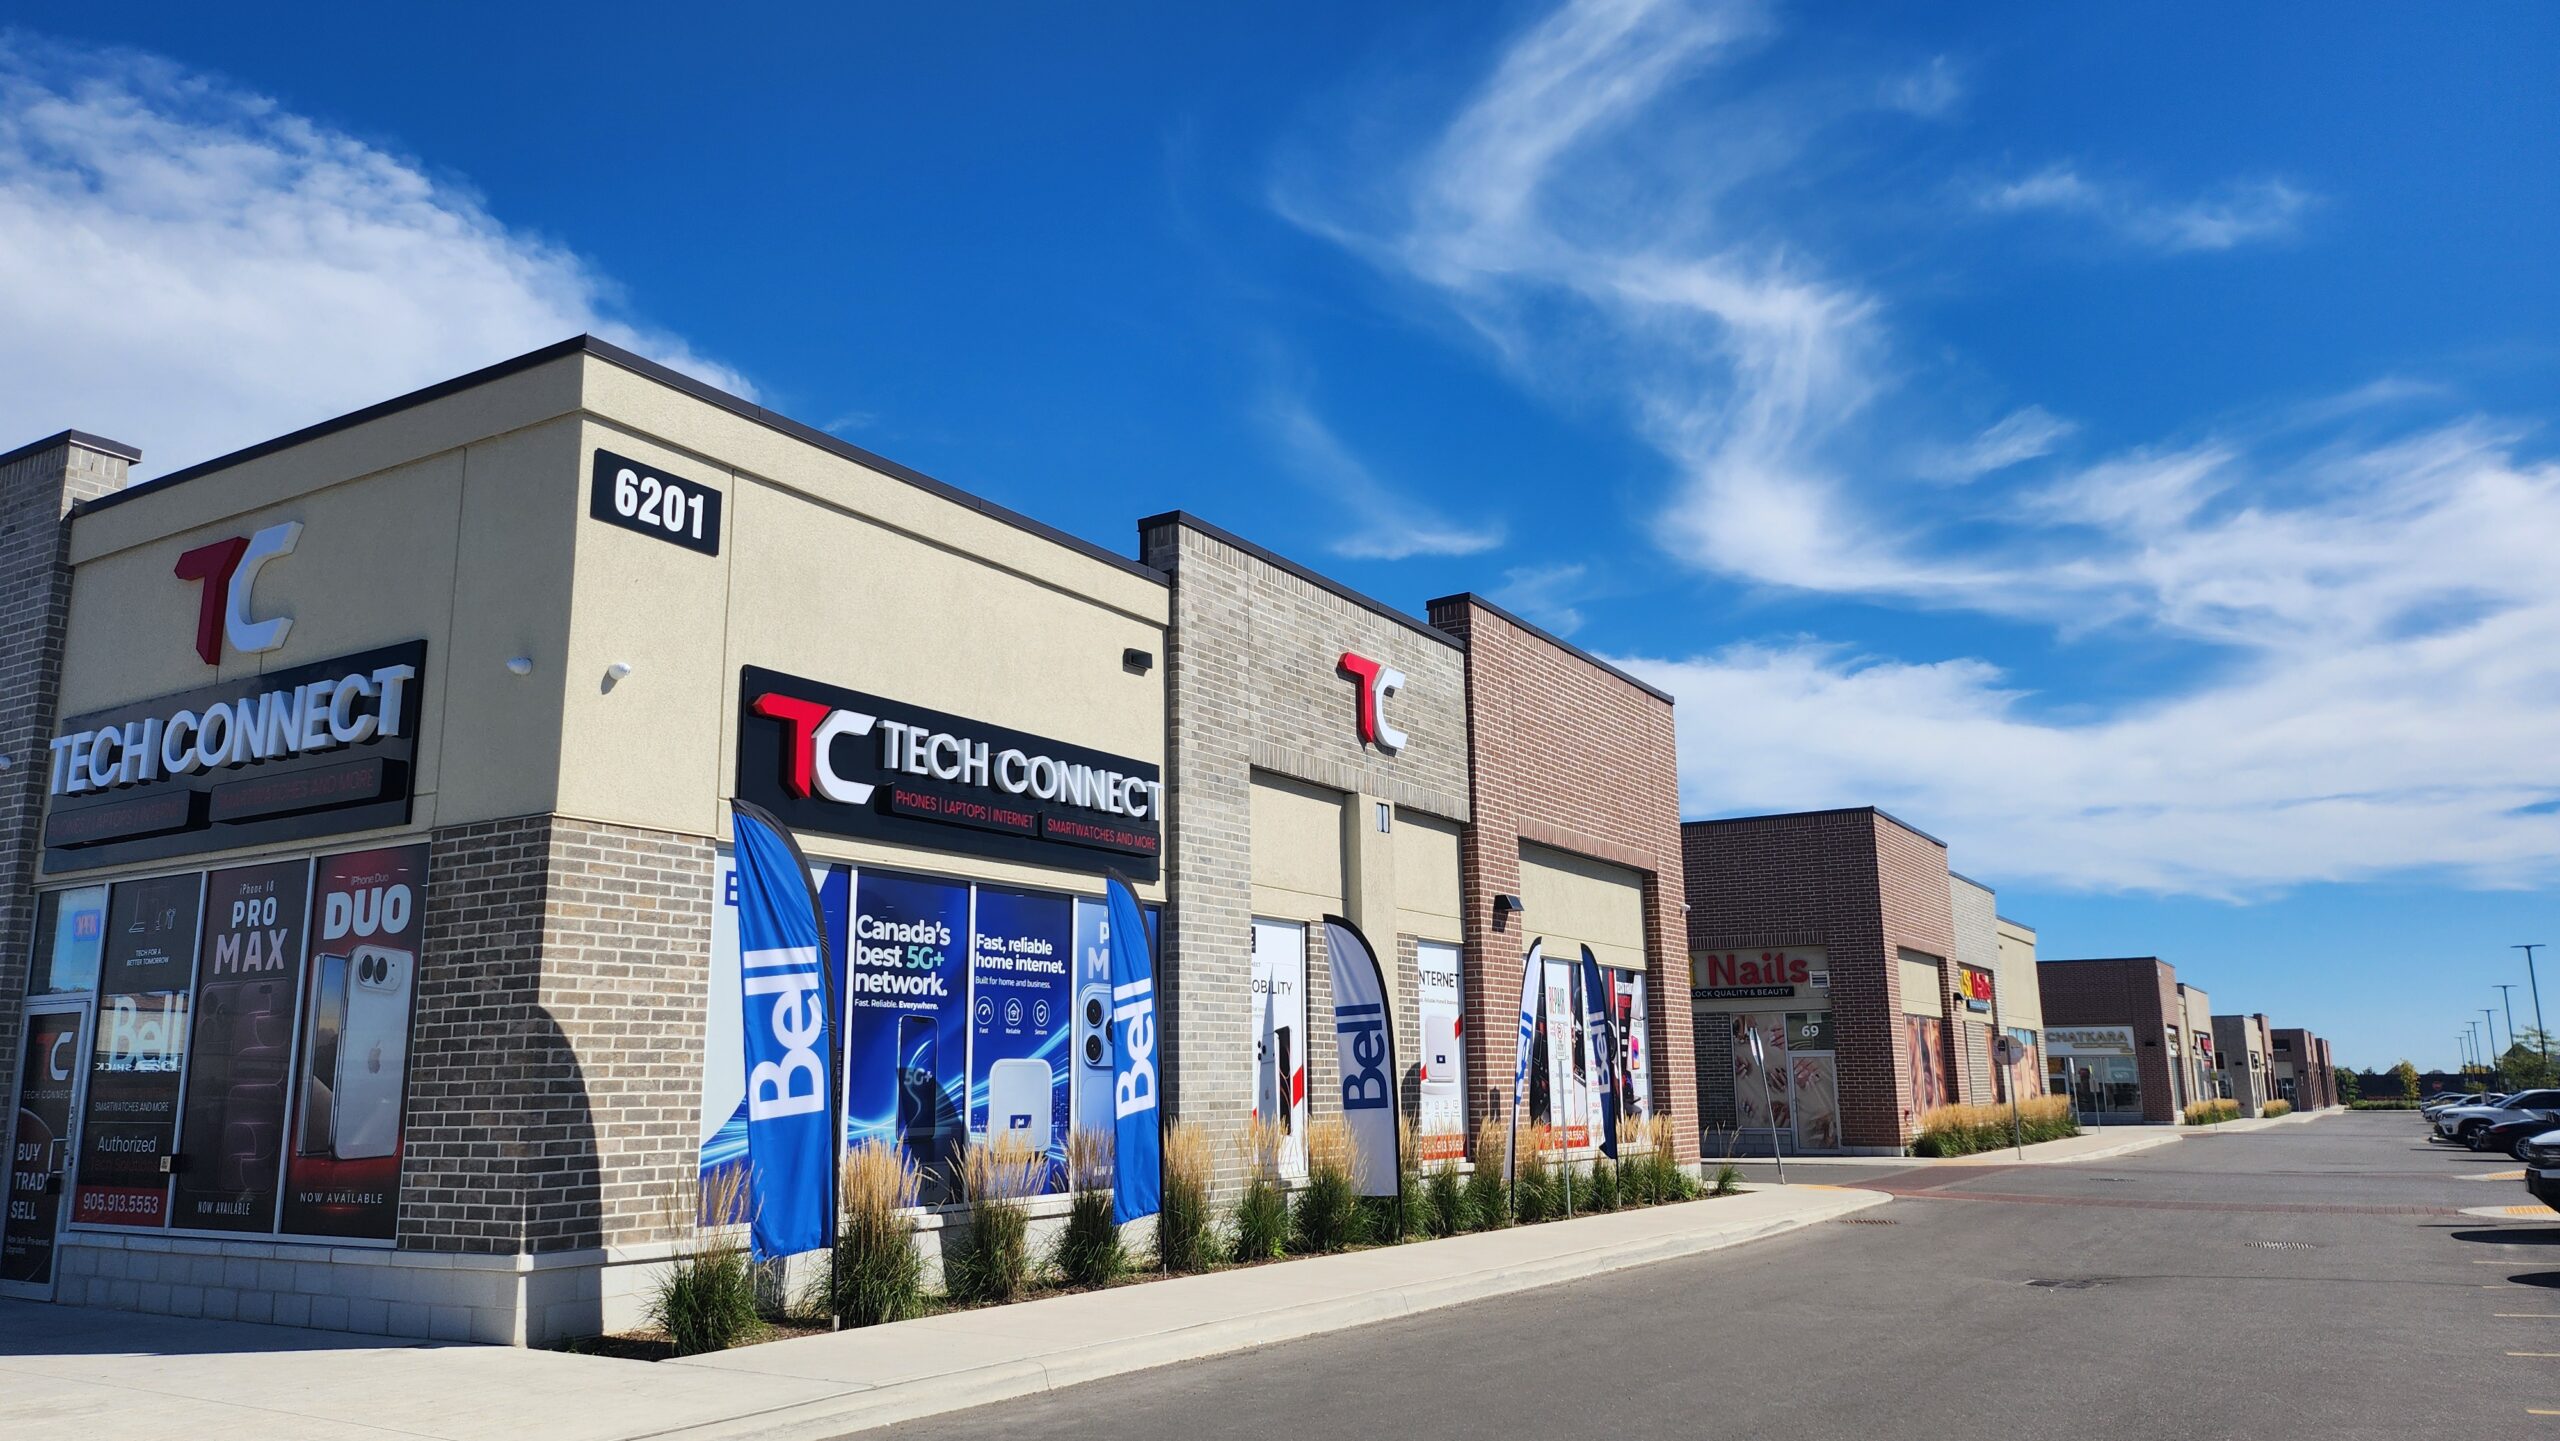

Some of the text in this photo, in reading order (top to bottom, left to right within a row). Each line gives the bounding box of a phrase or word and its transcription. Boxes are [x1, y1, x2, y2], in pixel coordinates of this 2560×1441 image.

[614, 468, 704, 539] 6201
[174, 520, 304, 665] TC
[1336, 651, 1408, 751] TC
[50, 664, 415, 796] TECH CONNECT
[753, 692, 877, 805] TC
[876, 718, 1164, 821] TECH CONNECT
[895, 789, 1033, 829] PHONES LAPTOPS INTERNET
[1047, 817, 1157, 850] SMARTWATCHES AND MORE
[239, 883, 262, 895] iPhone
[351, 873, 389, 886] iPhone Duo
[231, 896, 278, 929] PRO
[323, 883, 412, 940] DUO
[856, 913, 950, 946] Canada's
[214, 927, 288, 975] MAX
[856, 942, 944, 970] best 5G+
[975, 932, 1052, 955] Fast, reliable
[126, 956, 169, 967] BETTER TOMORROW
[975, 951, 1013, 970] home
[1015, 954, 1066, 975] internet.
[1707, 952, 1809, 987] Nails
[854, 969, 948, 997] network.
[989, 977, 998, 985] for
[998, 977, 1015, 986] home
[1015, 979, 1027, 987] and
[1251, 978, 1293, 996] OBILITY
[1418, 969, 1460, 988] NTERNET
[854, 998, 939, 1011] Fast. Reliable. Everywhere.
[1691, 988, 1790, 998] LOCK QUALITY & BEAUTY
[109, 994, 184, 1070] Bell
[743, 945, 825, 1123] Bell
[1801, 1025, 1819, 1037] 69
[2045, 1031, 2128, 1043] CHATKARA
[1113, 977, 1156, 1120] Bell
[1335, 1002, 1389, 1111] Bell
[1589, 1010, 1611, 1094] Bell
[904, 1067, 933, 1086] 5G+
[95, 1101, 169, 1112] SMARTWATCHES AND MORE
[18, 1142, 42, 1162] BUY
[97, 1135, 157, 1153] Authorized
[10, 1200, 37, 1220] SELL
[83, 1192, 159, 1214] 905.913.5553
[198, 1200, 251, 1217] NOW AVAILABLE
[300, 1191, 383, 1204] NOW AVAILABLE
